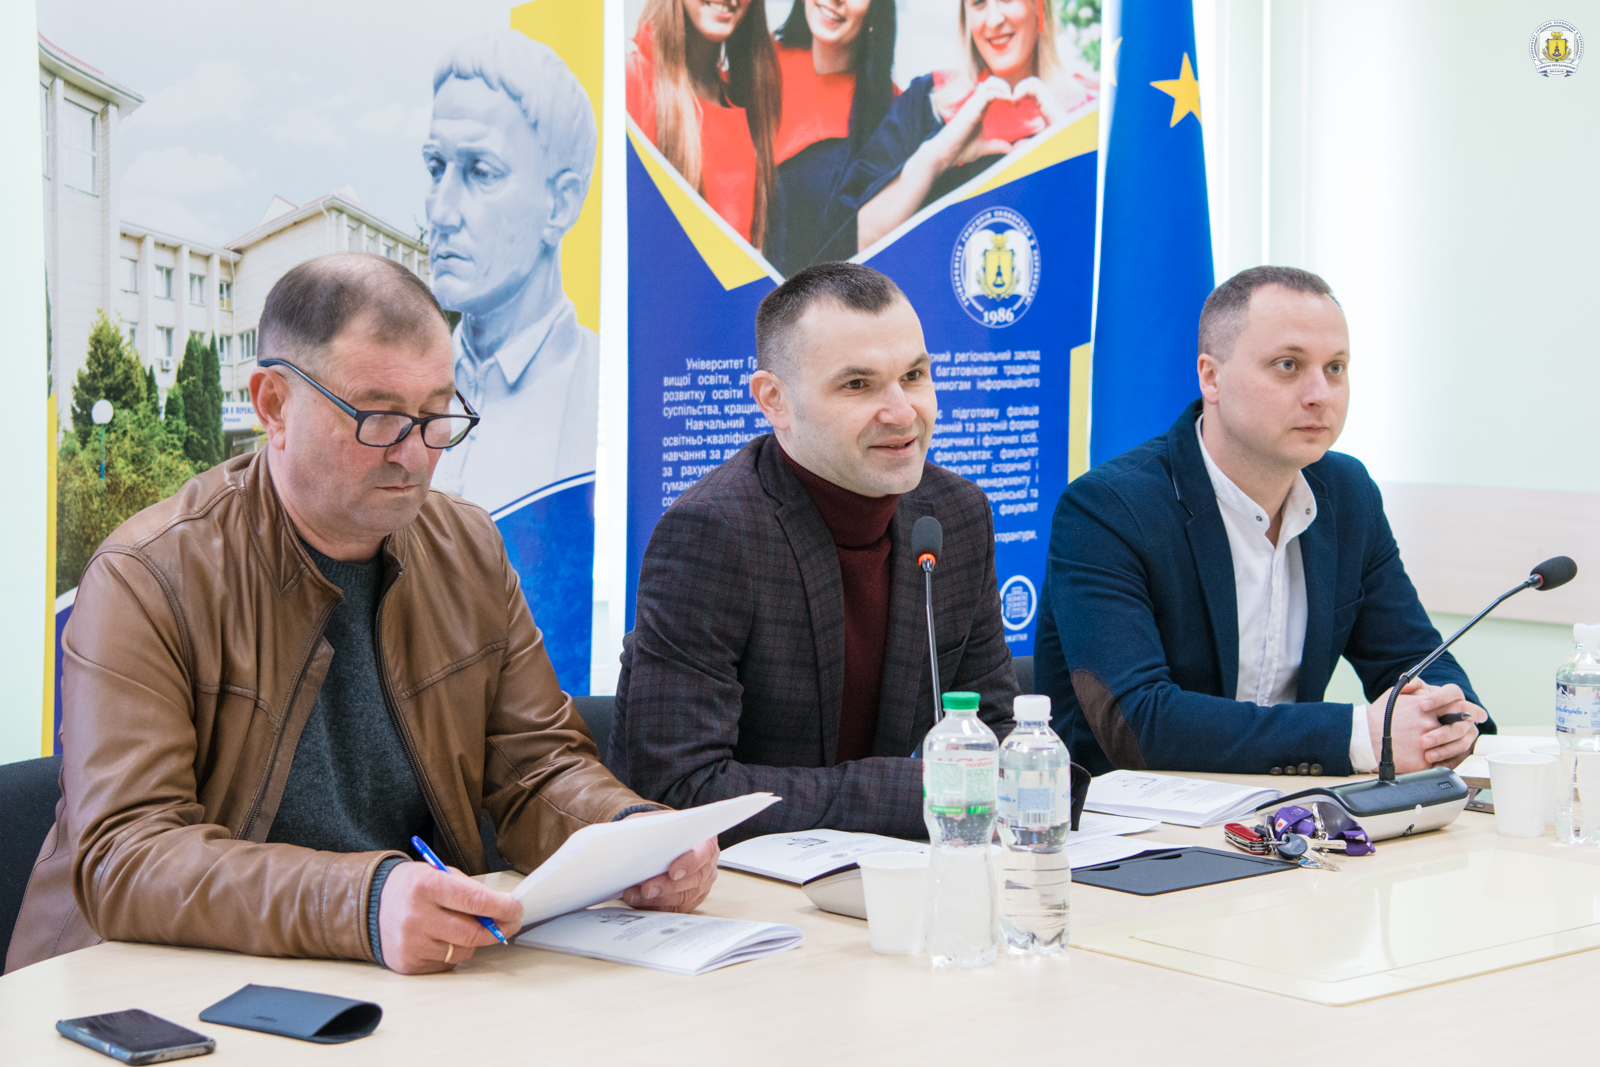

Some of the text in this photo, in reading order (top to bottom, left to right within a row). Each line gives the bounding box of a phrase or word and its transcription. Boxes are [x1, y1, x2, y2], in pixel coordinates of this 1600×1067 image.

[983, 306, 1015, 326] 1986
[955, 350, 1012, 364] регіональний
[686, 358, 744, 372] Університет
[936, 365, 999, 377] багатовікових
[663, 374, 692, 387] вищої
[698, 372, 733, 386] освіти,
[663, 389, 707, 404] розвитку
[712, 387, 744, 400] освіти
[663, 404, 762, 419] суспільства, кращим
[952, 407, 1000, 420] підготовку
[686, 418, 746, 431] Навчальний
[964, 422, 976, 433] та
[663, 449, 707, 462] навчання
[709, 449, 721, 460] за
[662, 466, 673, 478] за
[986, 487, 1028, 503] країнської
